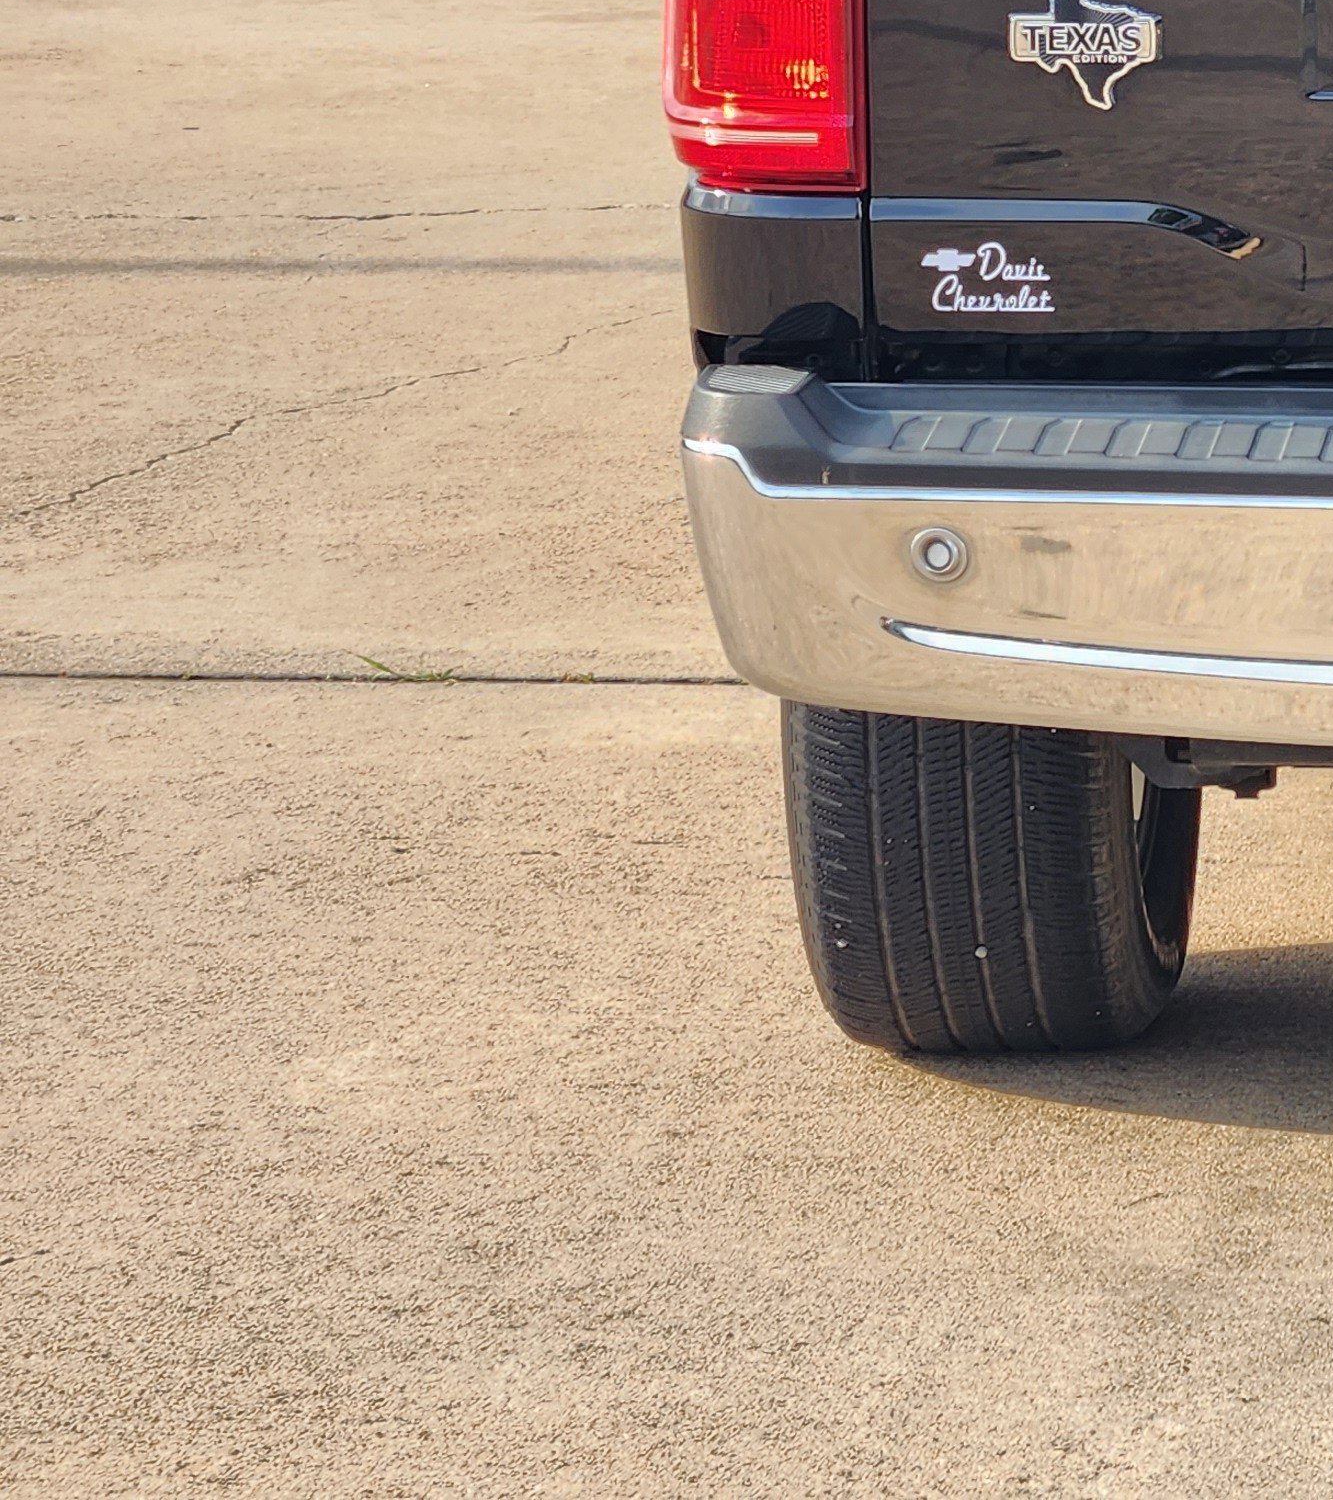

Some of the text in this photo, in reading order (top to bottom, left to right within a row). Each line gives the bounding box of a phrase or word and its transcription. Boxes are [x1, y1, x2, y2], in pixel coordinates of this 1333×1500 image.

[1020, 22, 1143, 55] TEXAS
[1072, 54, 1128, 64] EDITION
[977, 241, 1051, 281] Davis
[931, 274, 1056, 312] Chevrolet
